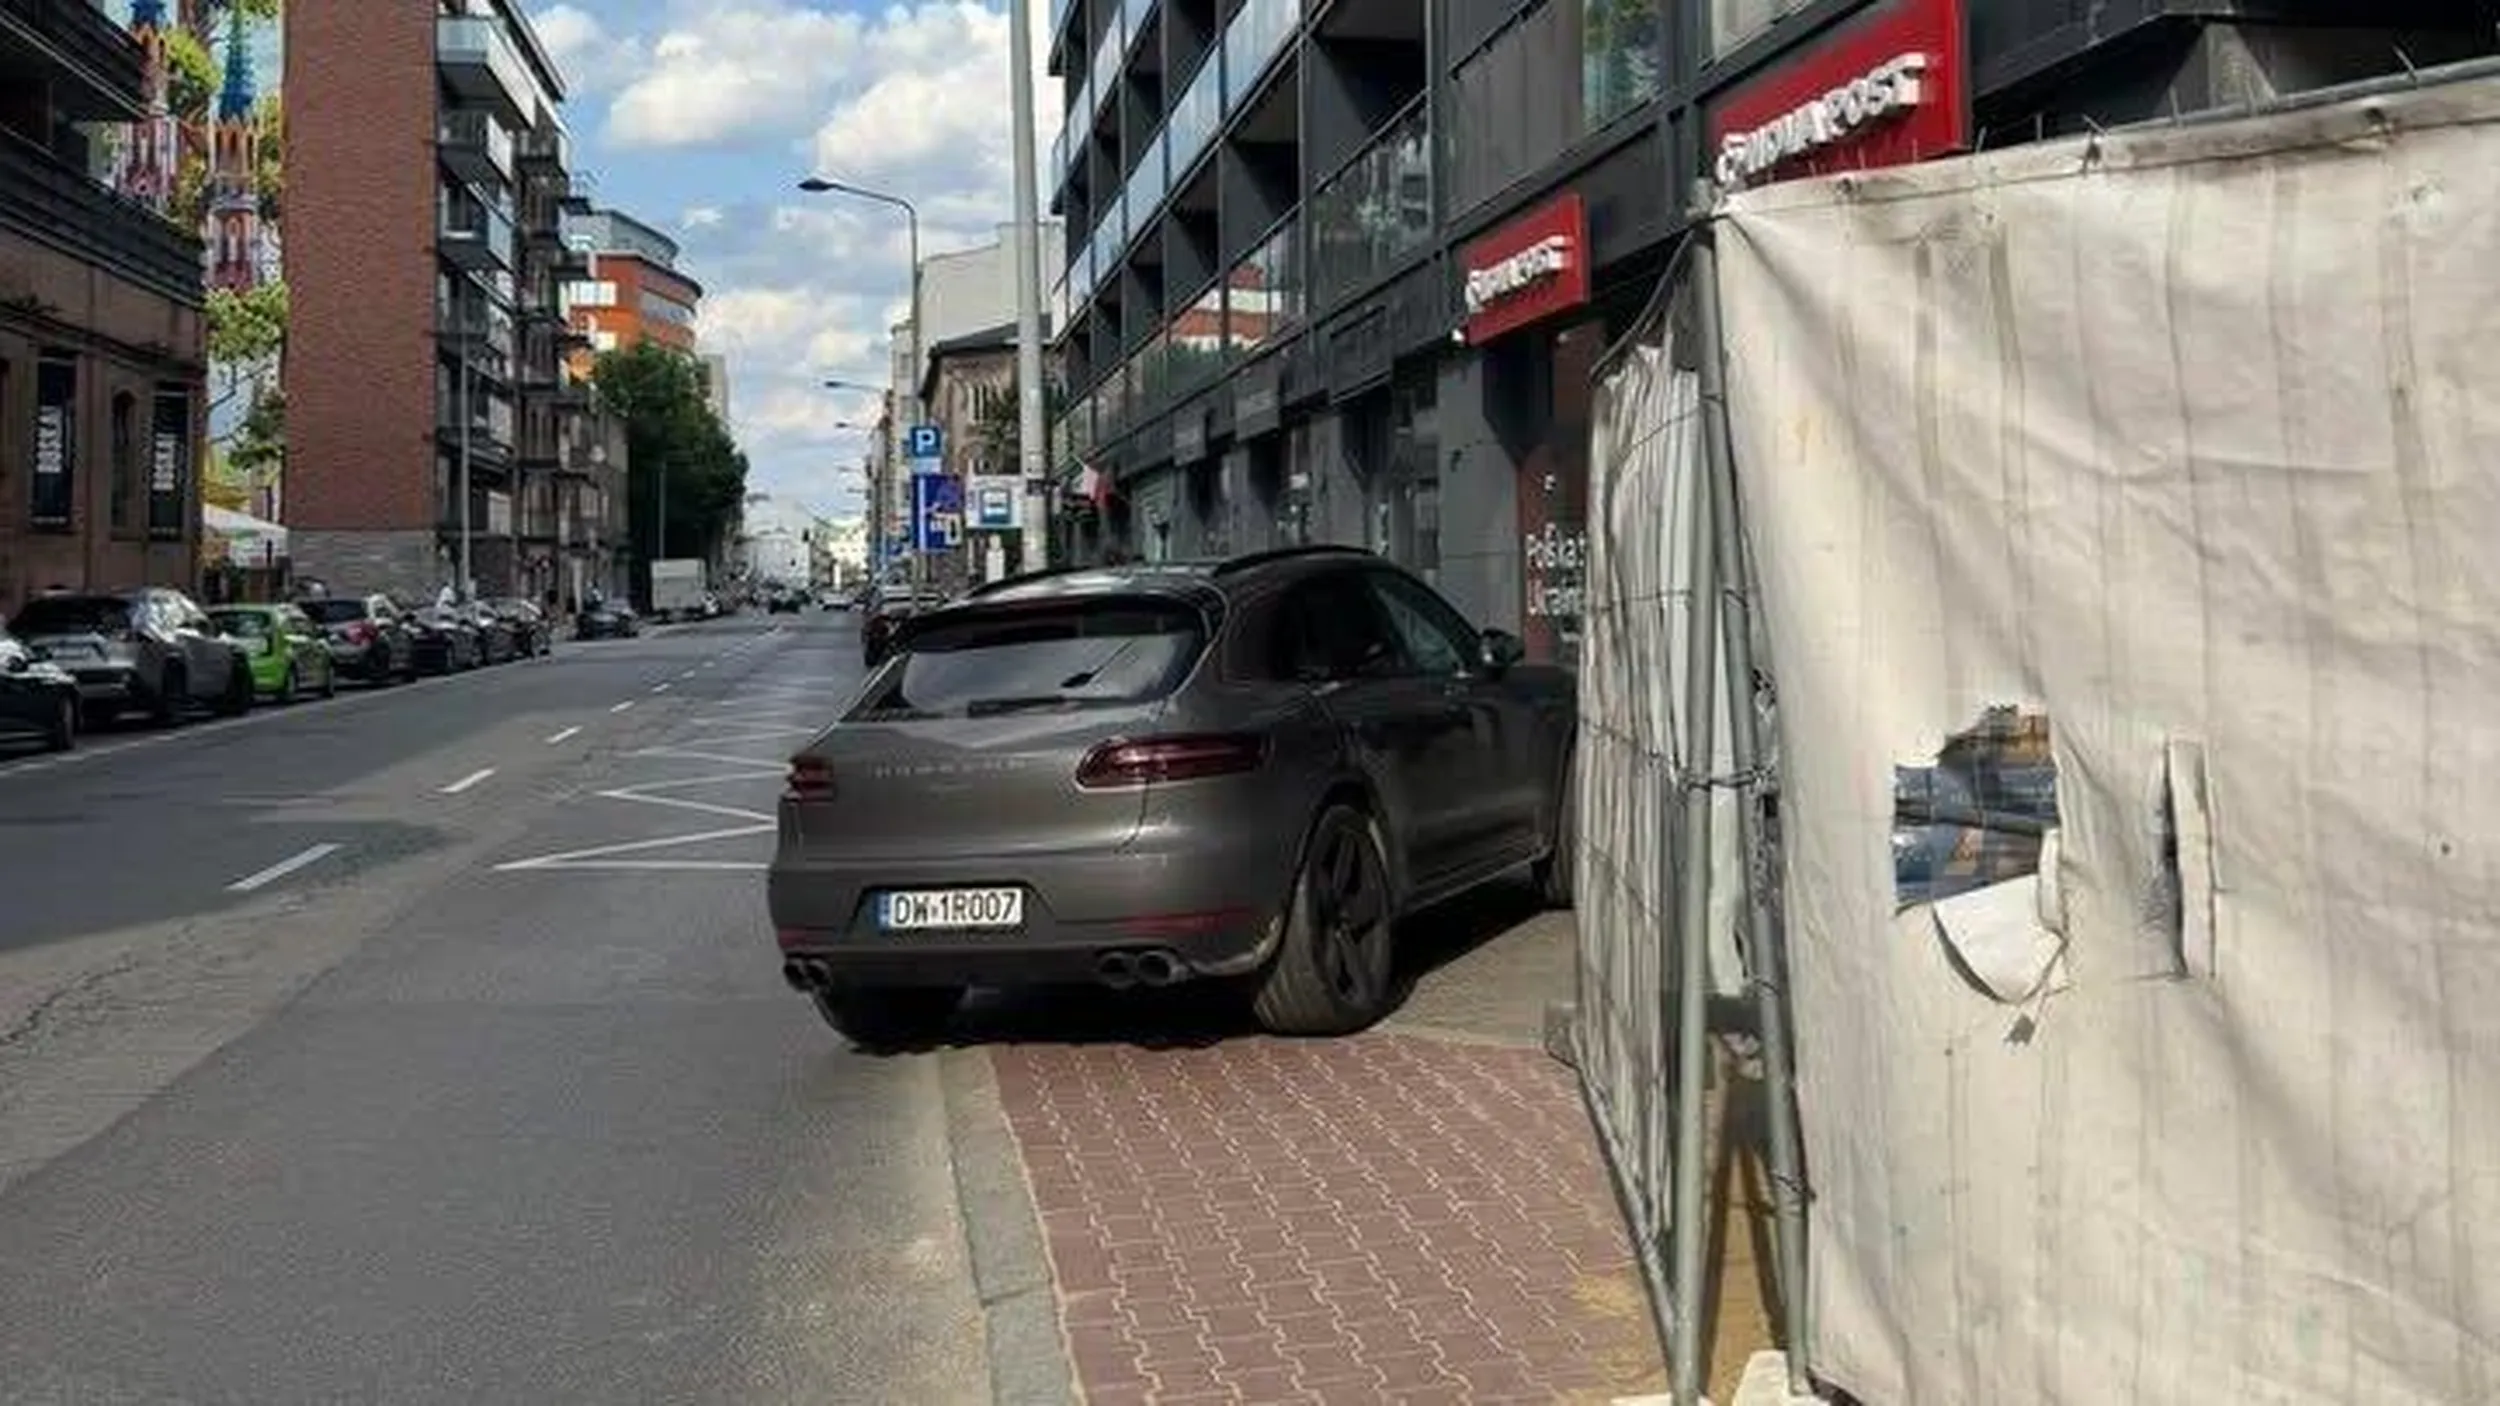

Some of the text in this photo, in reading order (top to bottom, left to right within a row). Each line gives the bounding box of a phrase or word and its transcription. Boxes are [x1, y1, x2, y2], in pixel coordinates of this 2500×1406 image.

[916, 429, 936, 453] P
[895, 891, 1017, 924] DW 1R007
